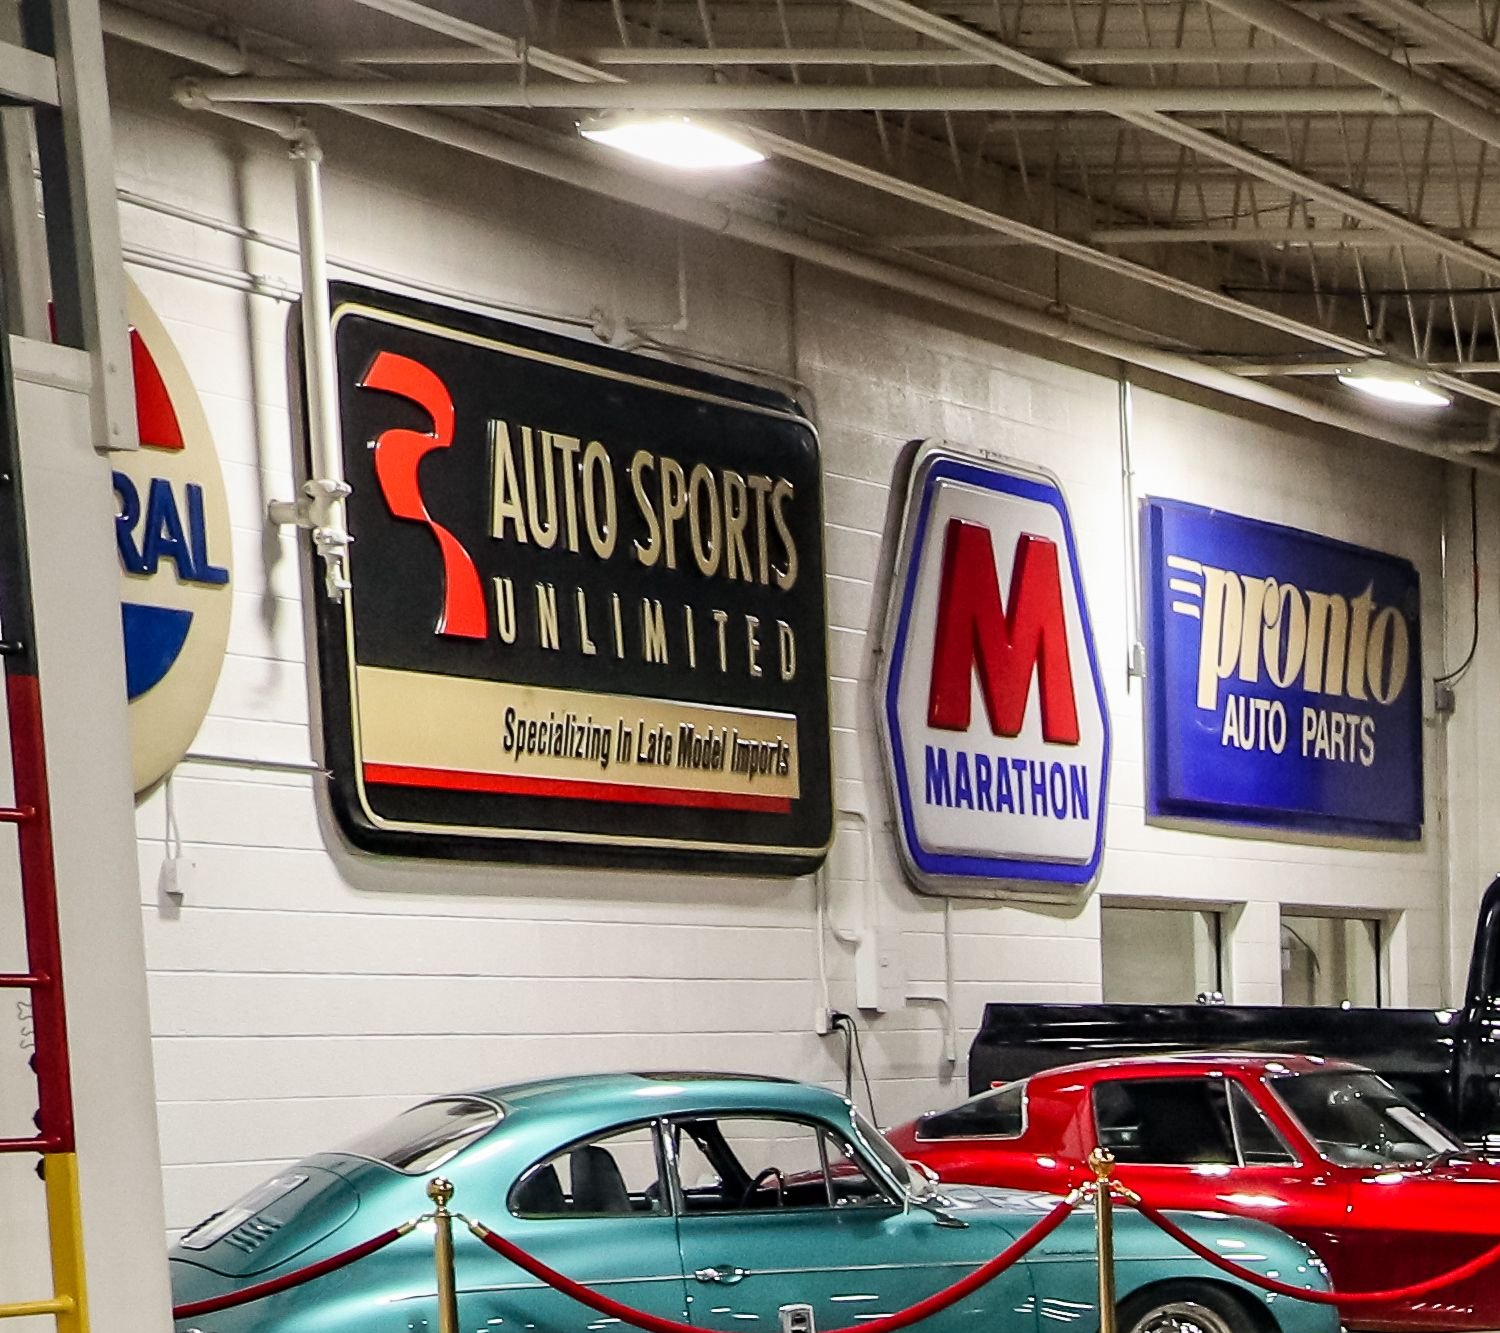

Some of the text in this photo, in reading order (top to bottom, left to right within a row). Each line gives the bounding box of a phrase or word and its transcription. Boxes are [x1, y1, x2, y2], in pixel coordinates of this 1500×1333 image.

[488, 419, 799, 592] AUTO SPORTS
[493, 576, 797, 682] UNLIMITED
[927, 517, 1080, 746] M
[1198, 564, 1410, 711] pronto
[503, 706, 790, 783] Specializing In Late Model Imports
[925, 745, 1091, 821] MARATHON
[1221, 694, 1376, 768] AUTO PARTS
